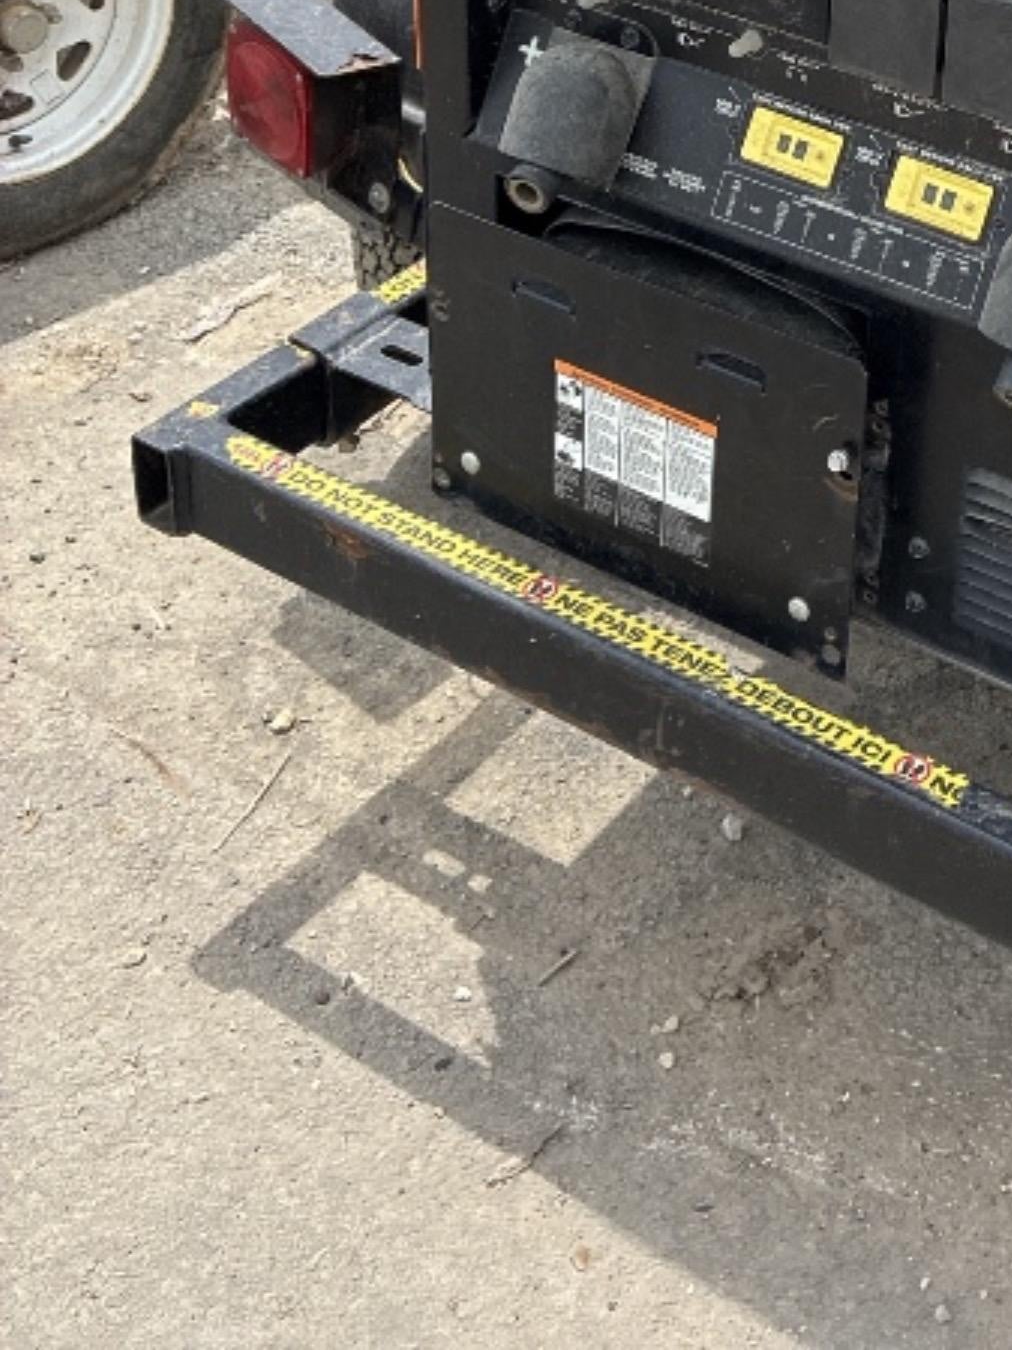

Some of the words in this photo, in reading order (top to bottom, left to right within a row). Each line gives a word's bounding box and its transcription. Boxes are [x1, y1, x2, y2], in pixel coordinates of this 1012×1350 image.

[289, 471, 325, 495] DO
[326, 489, 376, 514] NOT
[378, 510, 456, 554] STAND
[458, 547, 527, 586] HERE
[555, 590, 590, 617] NE
[595, 611, 646, 643] PAS
[733, 676, 853, 744] DEBOUT
[850, 735, 891, 764] ICI
